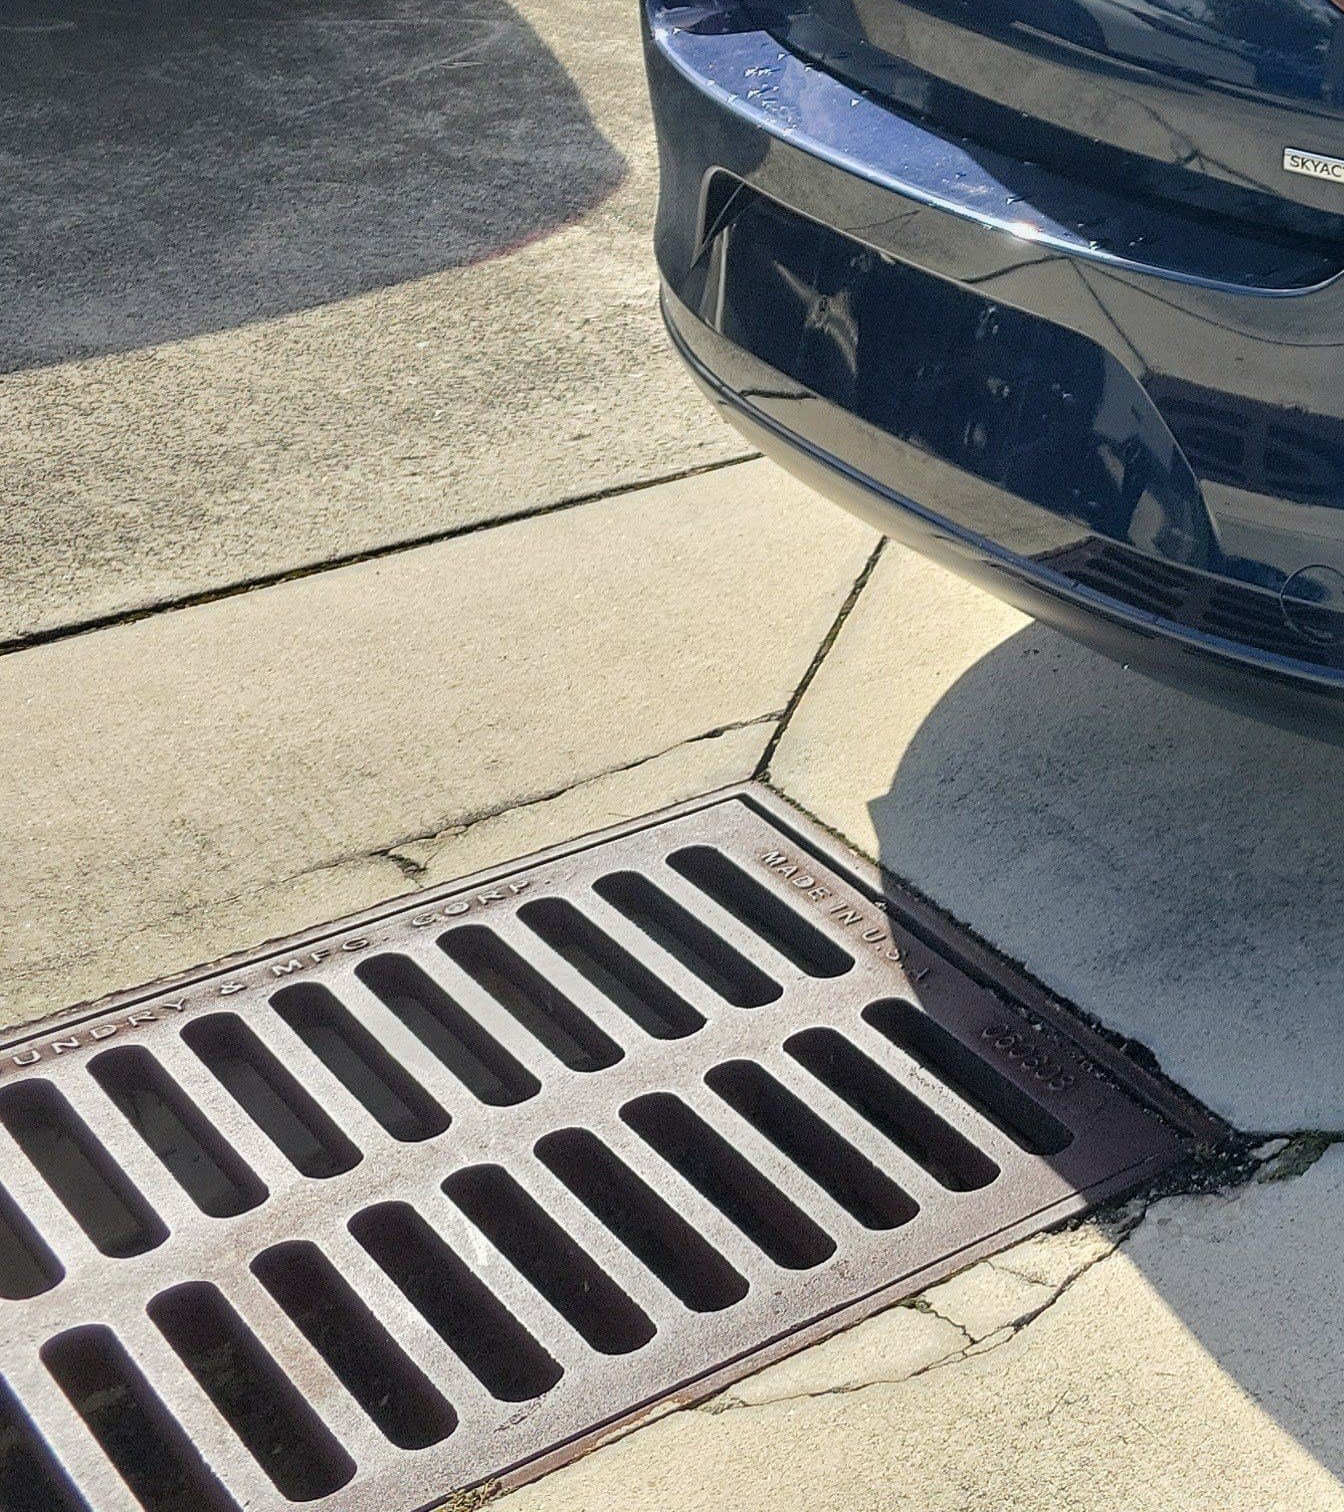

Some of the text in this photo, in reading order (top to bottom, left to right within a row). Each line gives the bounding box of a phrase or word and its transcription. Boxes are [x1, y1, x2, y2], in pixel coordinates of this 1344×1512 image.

[761, 849, 833, 902] MADE
[829, 901, 864, 927] IN
[3, 998, 188, 1068] UNDRY
